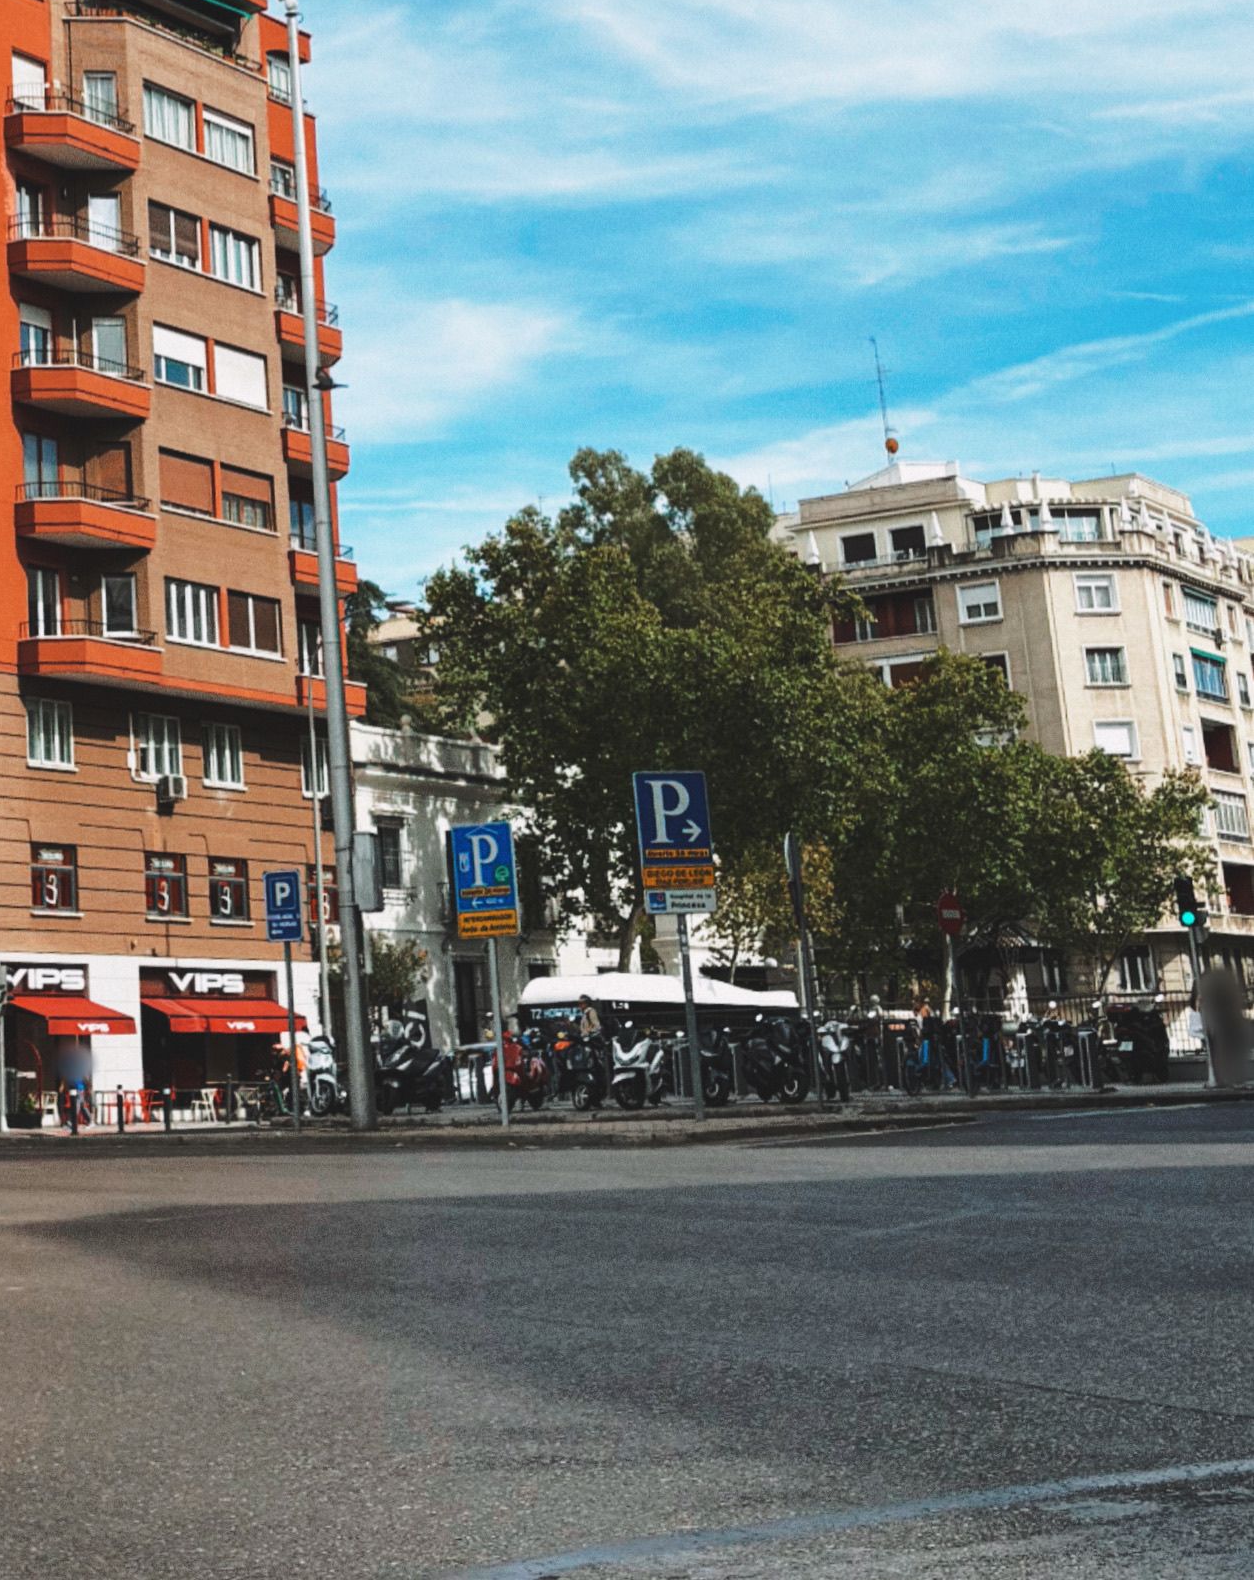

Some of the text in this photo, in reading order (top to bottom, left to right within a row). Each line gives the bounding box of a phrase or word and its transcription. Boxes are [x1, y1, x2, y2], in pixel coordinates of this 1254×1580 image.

[644, 780, 690, 844] P
[467, 834, 498, 886] P
[275, 882, 291, 907] P
[6, 969, 85, 990] VIPS
[168, 972, 245, 994] VIPS
[77, 1023, 110, 1033] VIPS
[226, 1021, 256, 1031] VIPS
